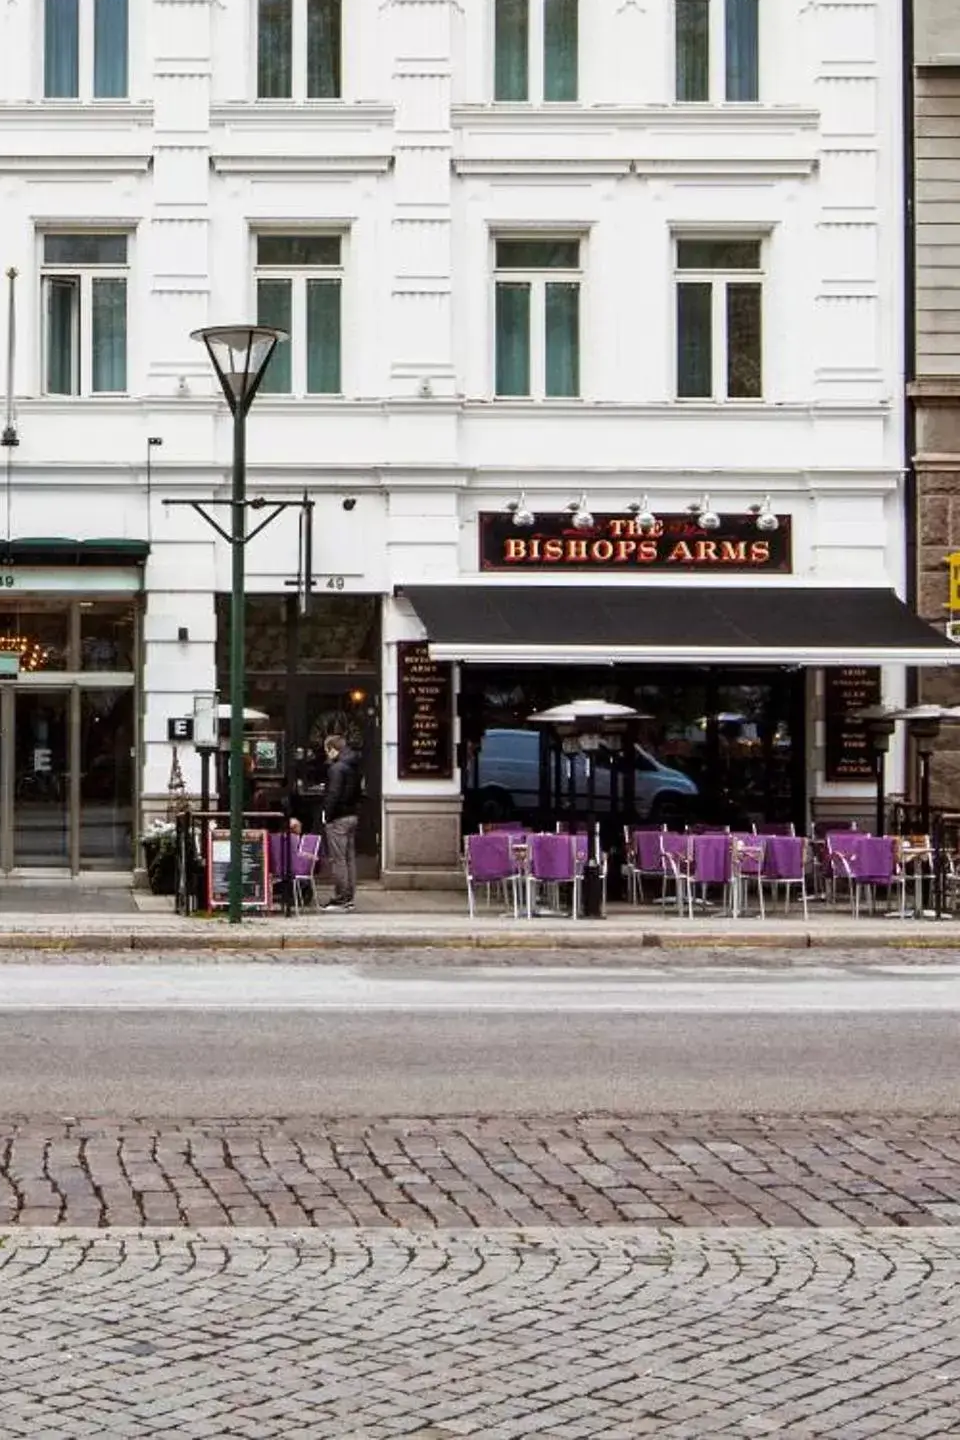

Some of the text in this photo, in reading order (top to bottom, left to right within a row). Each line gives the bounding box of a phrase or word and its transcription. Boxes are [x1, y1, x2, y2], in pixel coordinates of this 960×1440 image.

[609, 519, 665, 537] THE
[506, 539, 771, 561] BISHOPS ARMS
[326, 575, 345, 590] 49
[174, 720, 187, 736] E
[34, 748, 52, 771] E
